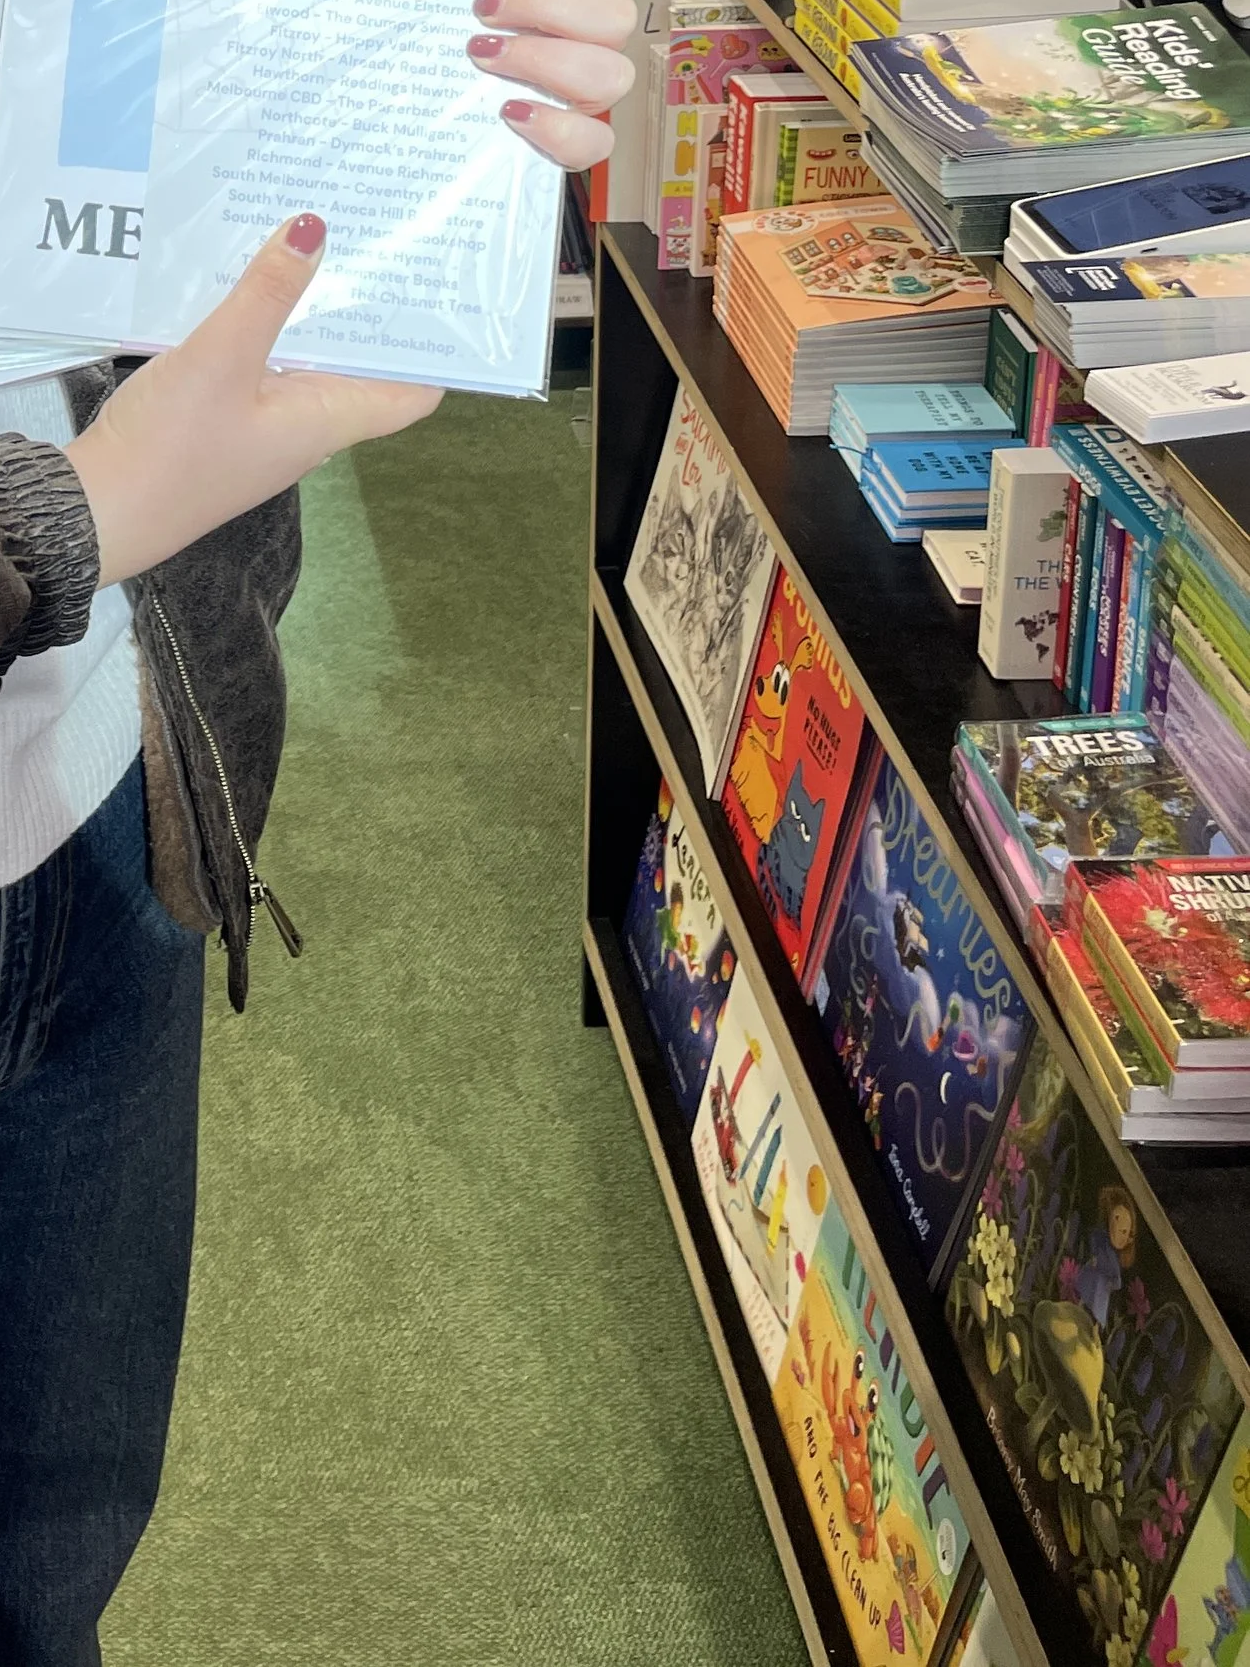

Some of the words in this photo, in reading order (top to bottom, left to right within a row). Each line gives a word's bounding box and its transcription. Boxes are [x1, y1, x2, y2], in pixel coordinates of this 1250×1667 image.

[325, 10, 350, 24] The
[270, 24, 320, 44] Fitzroy
[336, 32, 383, 53] Happy
[389, 38, 433, 58] Valley
[437, 44, 466, 59] Sho
[1081, 28, 1146, 86] Guide
[1145, 18, 1214, 70] Kids'
[226, 40, 277, 60] Fitzroy
[281, 46, 323, 63] North
[337, 53, 395, 74] Already
[400, 61, 436, 76] Read
[1111, 22, 1202, 101] Reading
[204, 79, 288, 102] Melbourne
[290, 90, 321, 106] CBD
[337, 95, 365, 111] The
[252, 64, 324, 86] Hawthorn
[340, 75, 407, 97] Readings
[260, 107, 336, 129] Northcote
[352, 118, 389, 135] Buck
[257, 128, 315, 147] Prahran
[330, 137, 402, 159] Dymock's
[408, 146, 466, 164] Prahran
[246, 148, 322, 168] Richmond
[337, 158, 393, 177] Avenue
[803, 166, 868, 189] FUNNY
[211, 165, 255, 182] South
[259, 170, 338, 192] Melbourne
[354, 181, 423, 203] Coventry
[228, 188, 271, 206] South
[275, 194, 313, 210] Yarra
[329, 200, 376, 217] Avoca
[413, 274, 458, 291] Books
[380, 292, 443, 312] Chesnut
[449, 300, 482, 316] Tree
[318, 327, 346, 342] The
[348, 330, 376, 345] Sun
[381, 334, 456, 356] Bookshop
[914, 390, 949, 427] THERAPIST
[934, 393, 955, 410] TELL
[948, 410, 963, 422] MY
[949, 390, 974, 415] THINGS
[970, 416, 984, 426] TO
[922, 451, 943, 469] WITH
[938, 468, 955, 480] MY
[945, 455, 970, 475] HOME
[964, 454, 979, 465] BE
[1077, 436, 1141, 496] EYEWITNESS
[1130, 496, 1170, 535] OCKET
[1037, 559, 1063, 574] TH
[1062, 543, 1072, 584] CARS
[1014, 576, 1049, 590] THE
[806, 692, 822, 719] NO
[818, 712, 843, 751] HUGS
[803, 718, 838, 770] PLEASE!
[1025, 730, 1145, 757] TREES
[1056, 758, 1075, 769] of
[1083, 753, 1156, 768] Australia
[802, 1415, 819, 1460] AND
[813, 1469, 831, 1508] THE
[827, 1511, 841, 1552] BIG
[840, 1548, 870, 1615] CLEAN
[867, 1604, 883, 1630] UP
[1012, 1465, 1033, 1513] May
[1032, 1507, 1058, 1572] Smith
